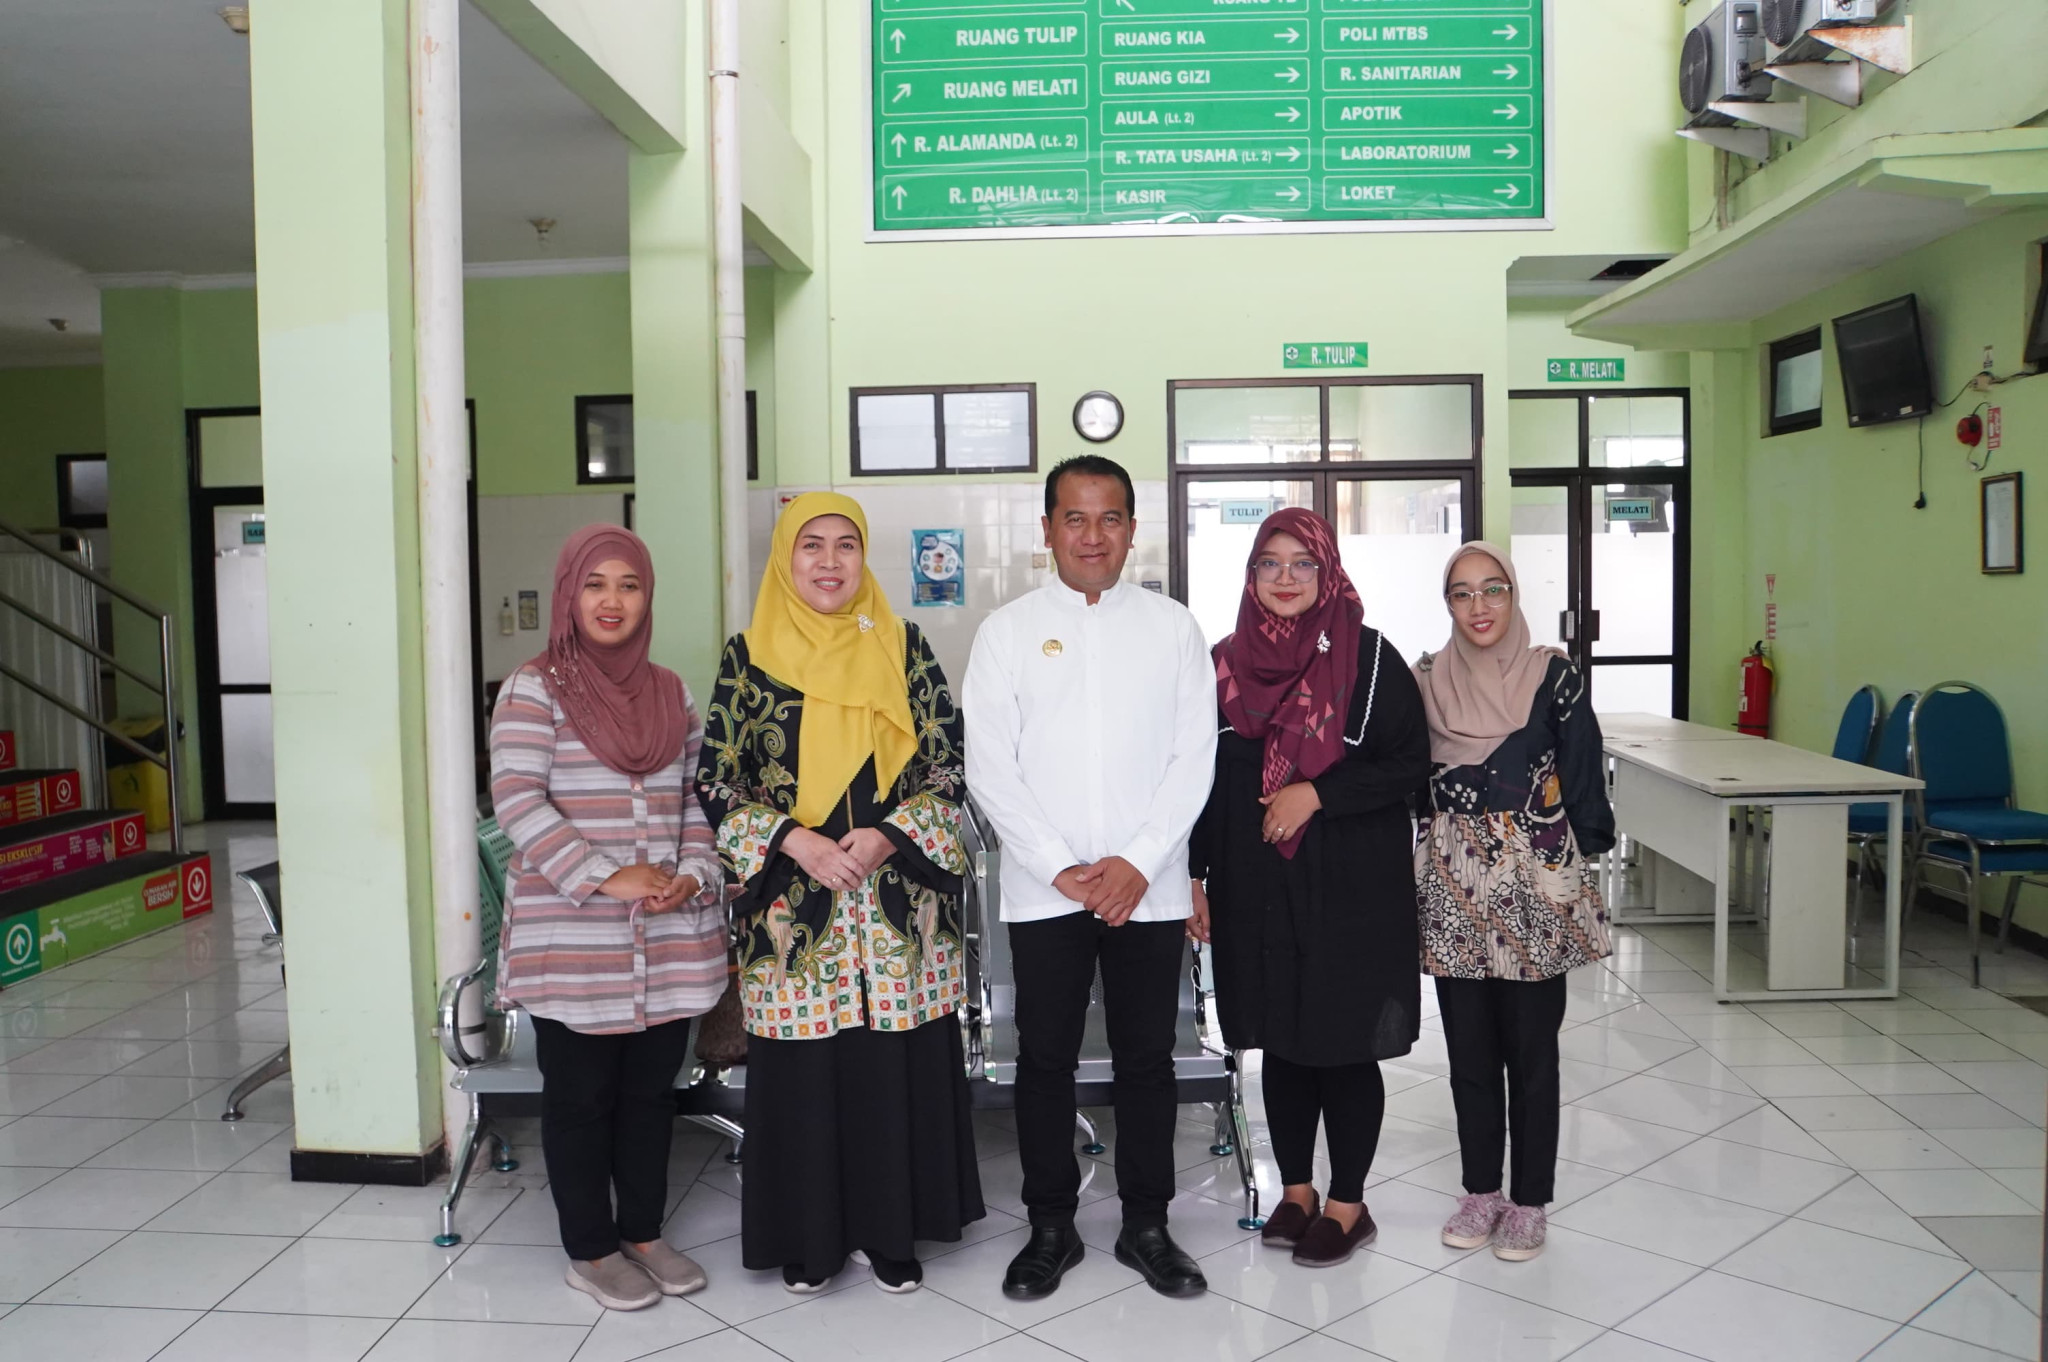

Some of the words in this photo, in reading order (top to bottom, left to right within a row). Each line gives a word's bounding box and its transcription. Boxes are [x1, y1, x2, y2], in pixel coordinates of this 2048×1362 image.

[956, 28, 1019, 47] RUANG
[1024, 26, 1078, 44] TULIP
[1114, 31, 1172, 46] RUANG
[1176, 30, 1206, 45] KIA
[1339, 27, 1377, 41] POLI
[1382, 26, 1428, 41] MTBS
[1114, 71, 1172, 86] RUANG
[1177, 69, 1210, 85] GIZI
[1340, 66, 1356, 81] R.
[1361, 65, 1461, 81] SANITARIAN
[943, 80, 1007, 99] RUANG
[1012, 78, 1078, 97] MELATI
[1115, 110, 1159, 126] AULA
[1164, 112, 1182, 126] (Lt.
[1184, 112, 1194, 126] 2)
[1340, 106, 1403, 121] APOTIK
[914, 135, 932, 153] R.
[936, 132, 1036, 151] ALAMANDA
[1040, 135, 1062, 150] (Lt.
[1065, 134, 1078, 149] 2)
[1115, 150, 1131, 165] R.
[1136, 149, 1177, 164] TATA
[1181, 148, 1238, 163] USAHA
[1241, 151, 1259, 165] (Lt.
[1261, 150, 1272, 164] 2)
[1341, 145, 1471, 161] LABORATORIUM
[949, 187, 967, 204] R.
[972, 185, 1038, 204] DAHLIA
[1041, 188, 1062, 204] (Lt.
[1066, 187, 1079, 202] 2)
[1115, 189, 1167, 205] KASIR
[1341, 185, 1396, 200] LOKET
[1311, 346, 1322, 365] R.
[1324, 346, 1356, 365] TULIP
[1569, 362, 1579, 379] R.
[1582, 361, 1617, 379] MELATI
[1229, 507, 1263, 517] TULIP
[1612, 505, 1649, 515] MELATI
[147, 888, 174, 907] BERSIH
